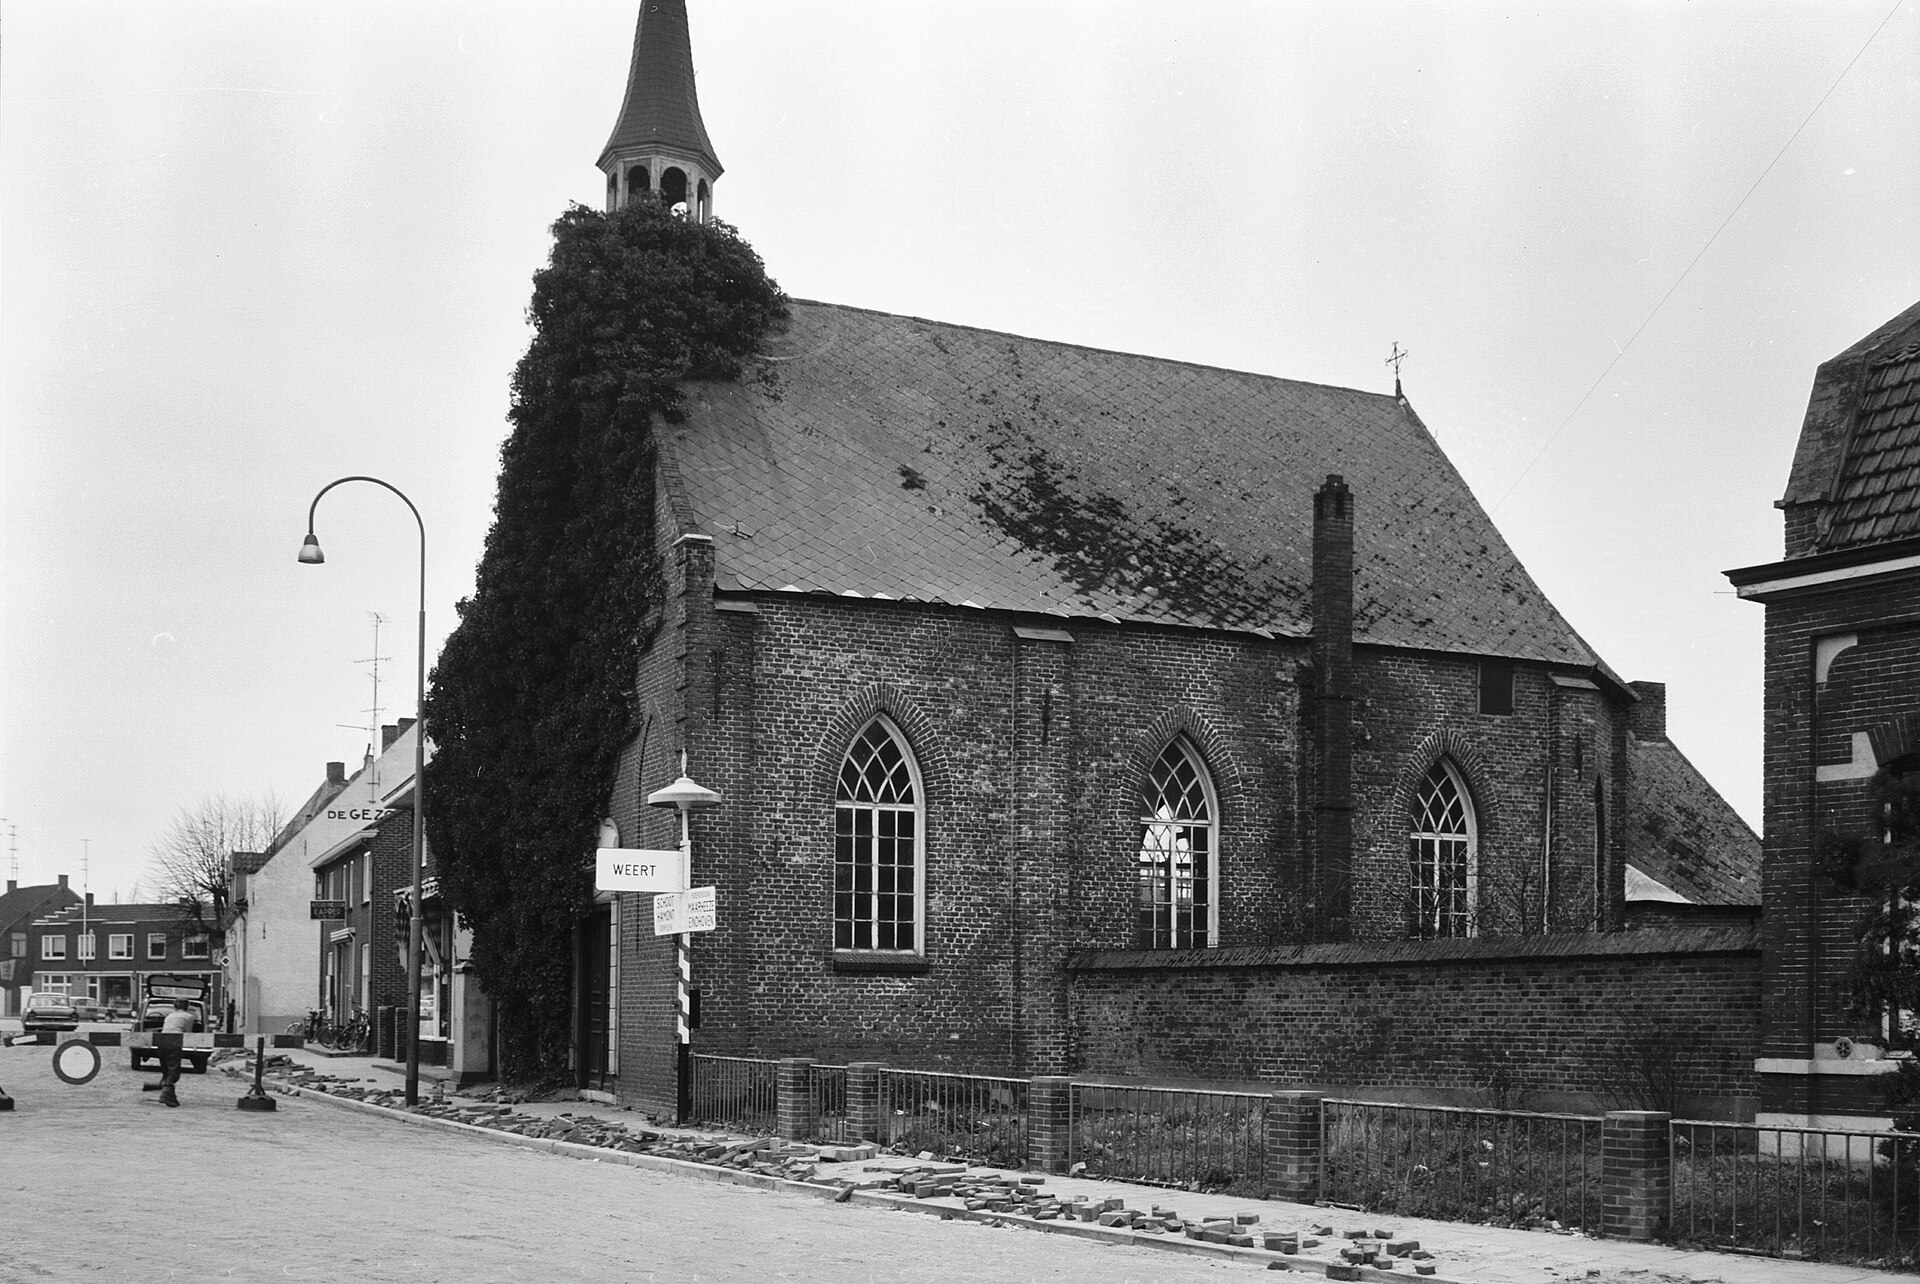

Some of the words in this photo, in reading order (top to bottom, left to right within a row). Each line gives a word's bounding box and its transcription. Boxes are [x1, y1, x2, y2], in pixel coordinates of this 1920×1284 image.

[327, 810, 347, 820] DE
[612, 863, 657, 877] WEERT
[656, 895, 675, 909] SCHOOT
[688, 899, 715, 913] MAARHEEZE
[656, 909, 675, 923] HAMONT
[688, 914, 715, 929] EINDHOVEN
